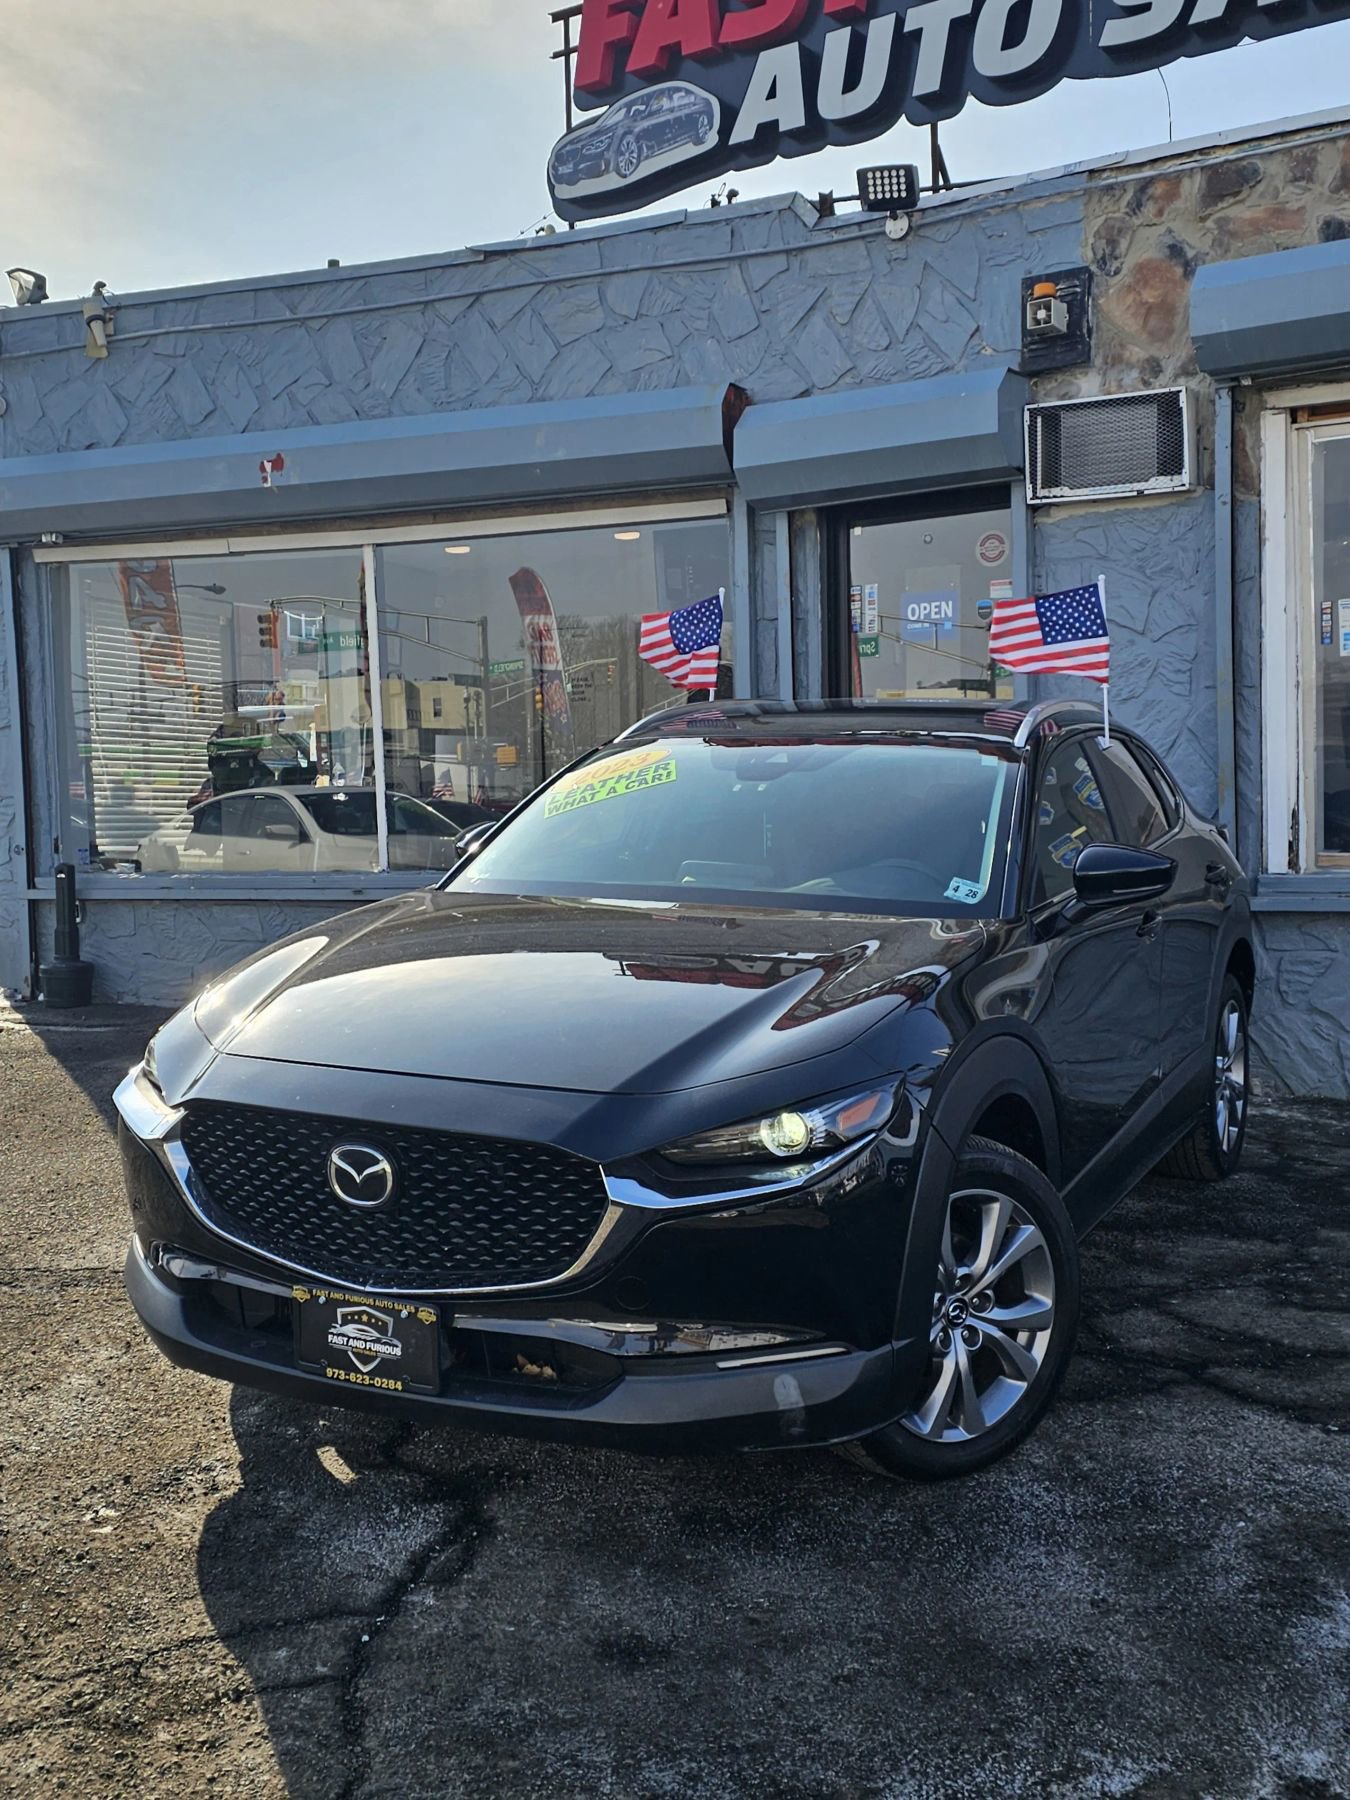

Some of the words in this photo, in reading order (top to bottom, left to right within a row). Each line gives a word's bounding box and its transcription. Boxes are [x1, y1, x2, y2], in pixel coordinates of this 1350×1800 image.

[574, 0, 866, 89] FA
[729, 0, 1062, 145] AUTO
[907, 600, 953, 620] OPEN
[575, 752, 651, 786] 2023
[547, 791, 600, 816] WHAT
[606, 786, 617, 797] A
[625, 771, 673, 791] CAR!
[548, 762, 671, 806] LEATHER
[952, 885, 960, 893] 4
[965, 888, 979, 899] 28
[312, 1288, 329, 1298] FAST
[329, 1291, 344, 1301] AND
[345, 1293, 374, 1306] FURIOUS
[375, 1299, 394, 1309] AUTO
[394, 1302, 416, 1313] SALES
[327, 1333, 348, 1345] FAST
[348, 1337, 366, 1350] AND
[366, 1341, 402, 1357] FURIOUS
[325, 1367, 403, 1391] 973-623-0284
